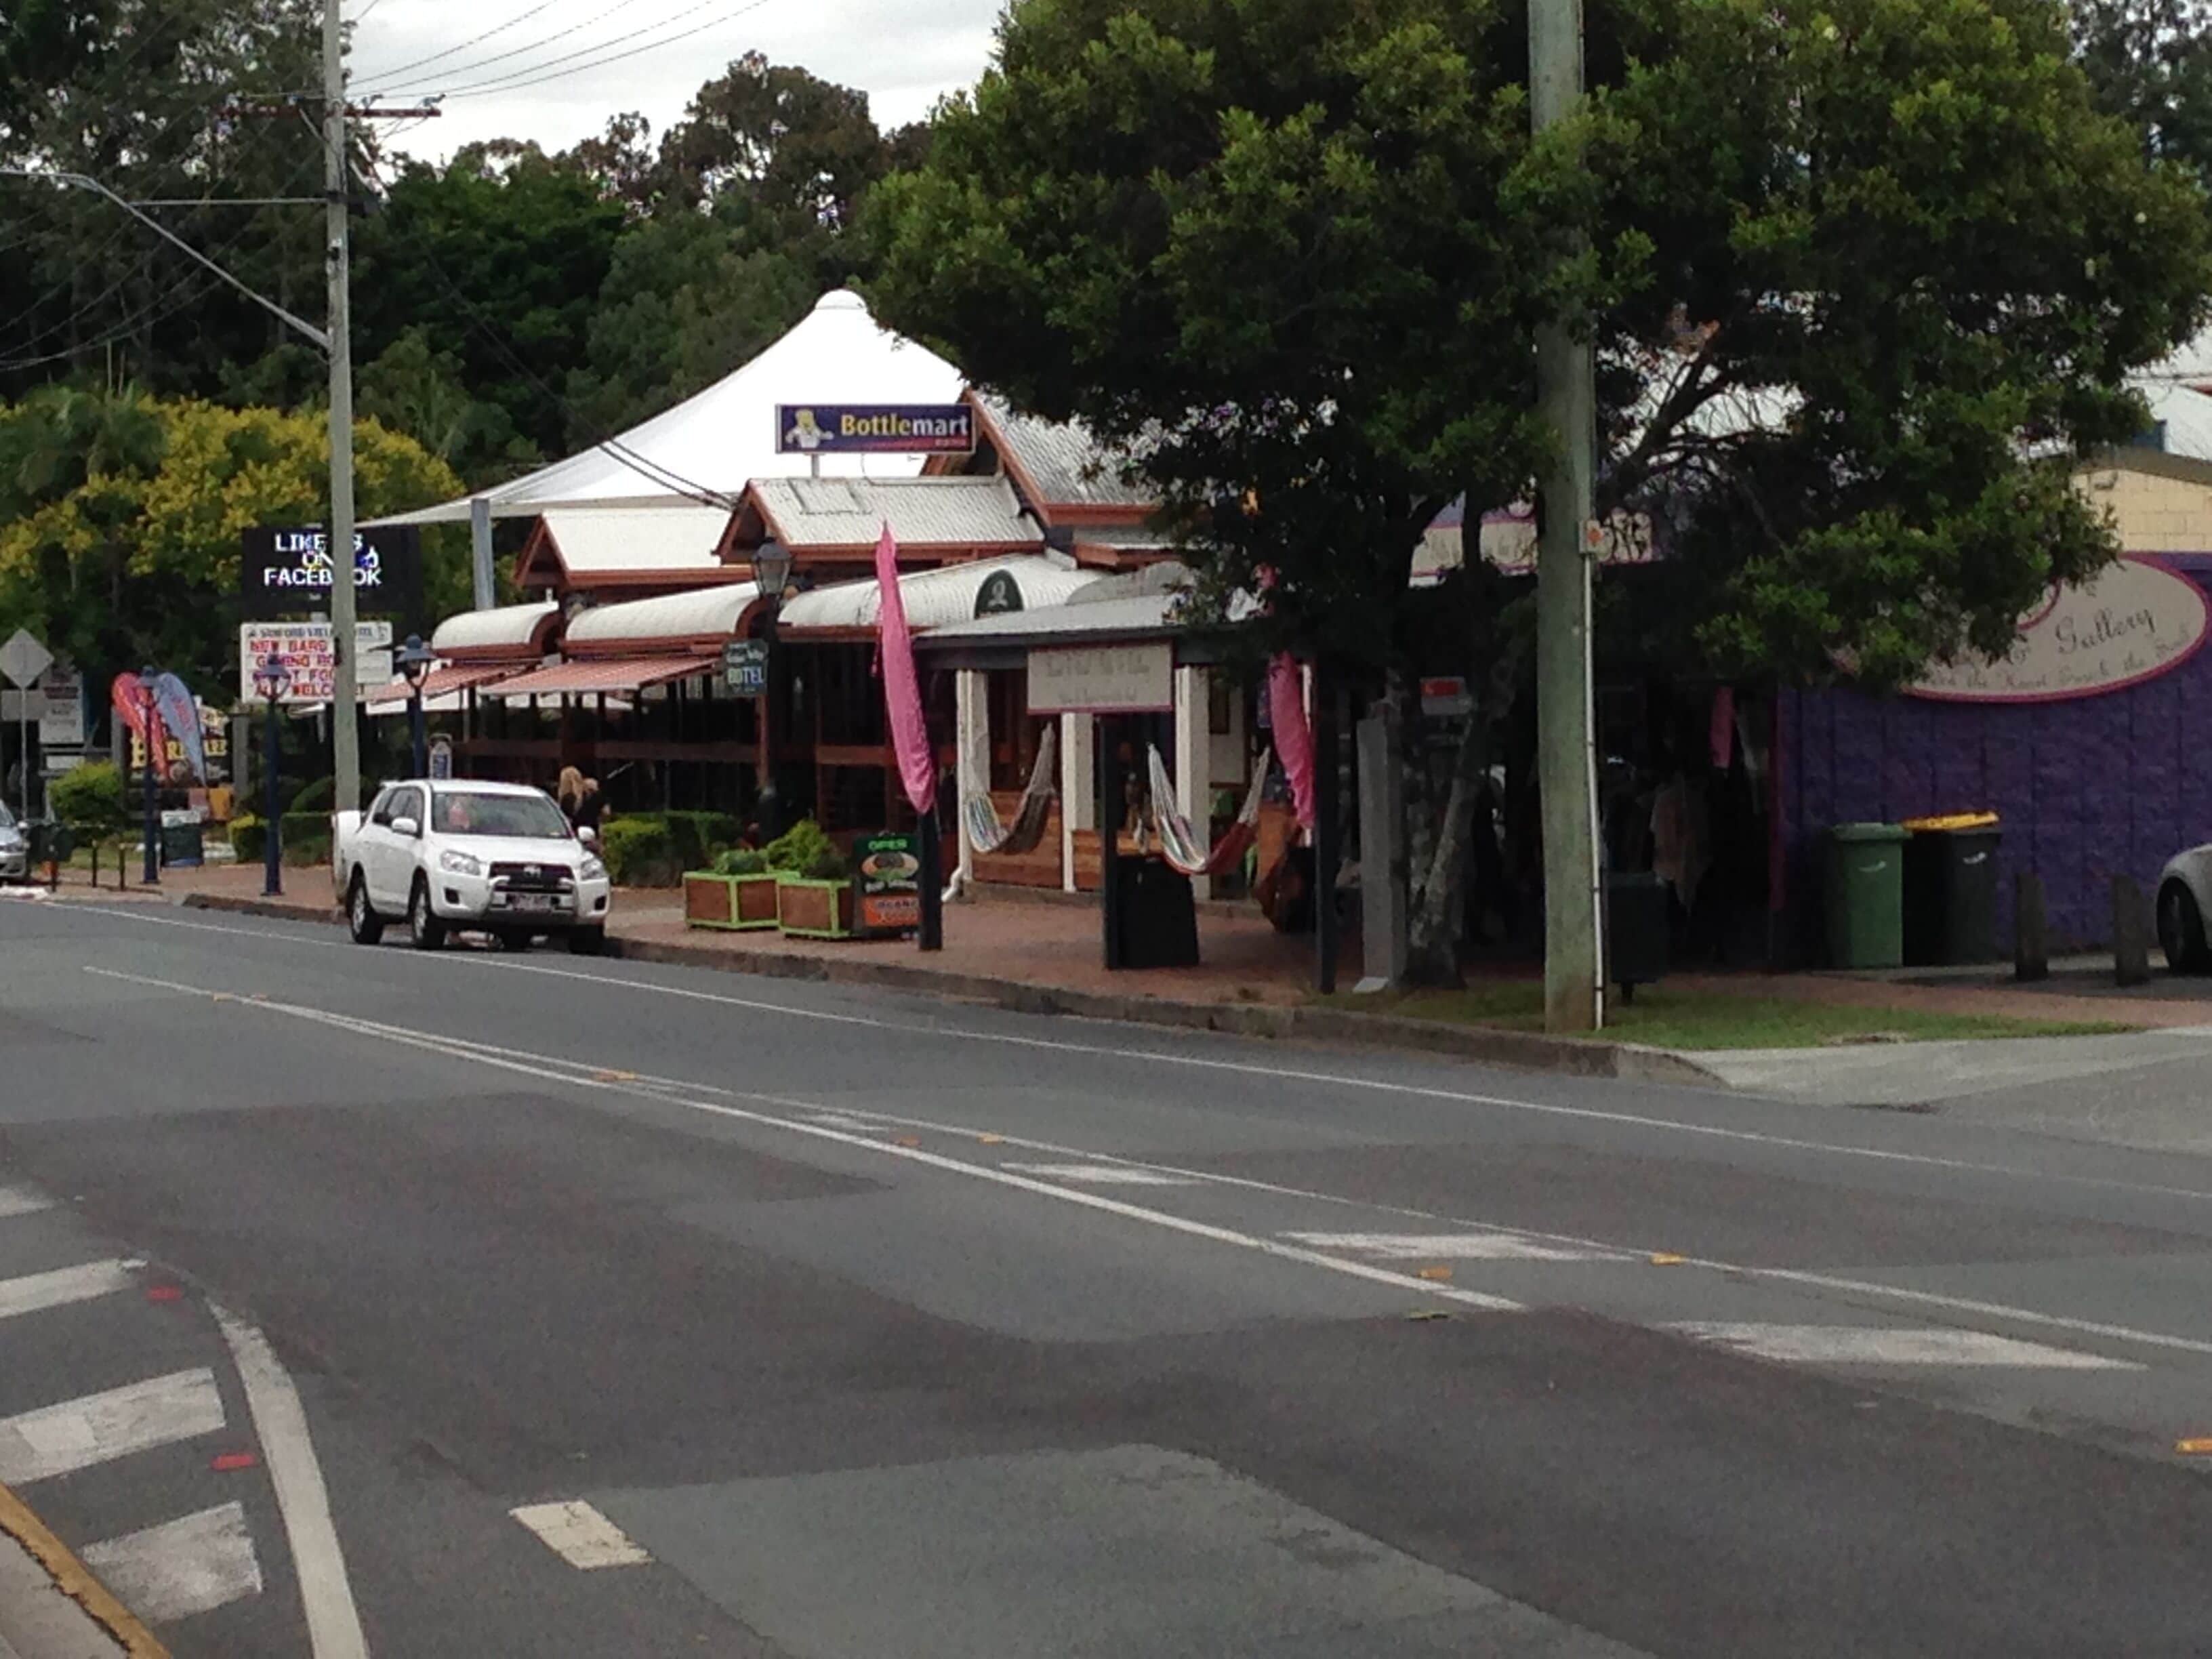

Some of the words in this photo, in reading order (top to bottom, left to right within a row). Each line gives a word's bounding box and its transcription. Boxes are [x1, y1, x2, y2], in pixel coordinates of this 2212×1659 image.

[840, 413, 968, 436] Bottlemart
[274, 533, 327, 551] LIKE
[264, 567, 382, 586] FACEBOK
[2055, 607, 2156, 655] Gallery
